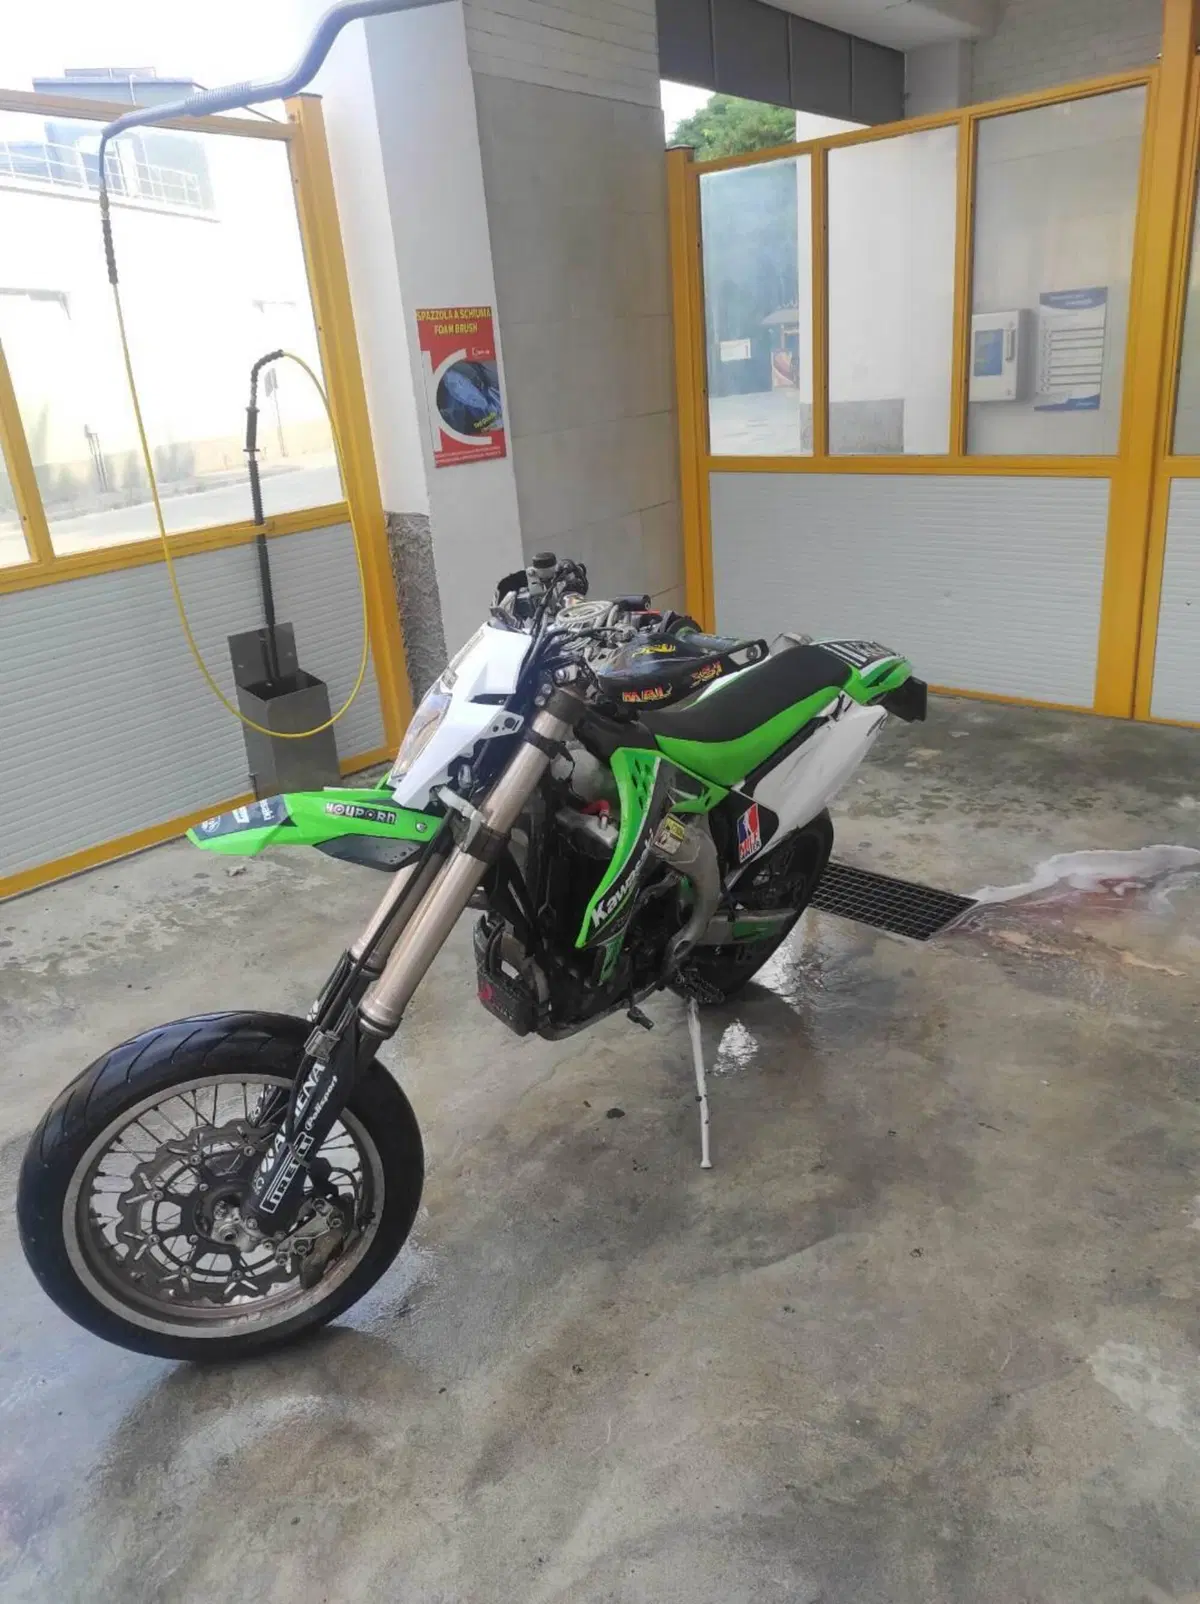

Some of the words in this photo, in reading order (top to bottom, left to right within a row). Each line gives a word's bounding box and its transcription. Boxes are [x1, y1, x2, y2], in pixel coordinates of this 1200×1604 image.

[417, 309, 454, 321] SPAZZOLA
[460, 307, 491, 319] SCHIUMA
[434, 323, 454, 337] FOAM
[455, 322, 478, 335] BRUSH
[305, 1075, 338, 1131] Polisport
